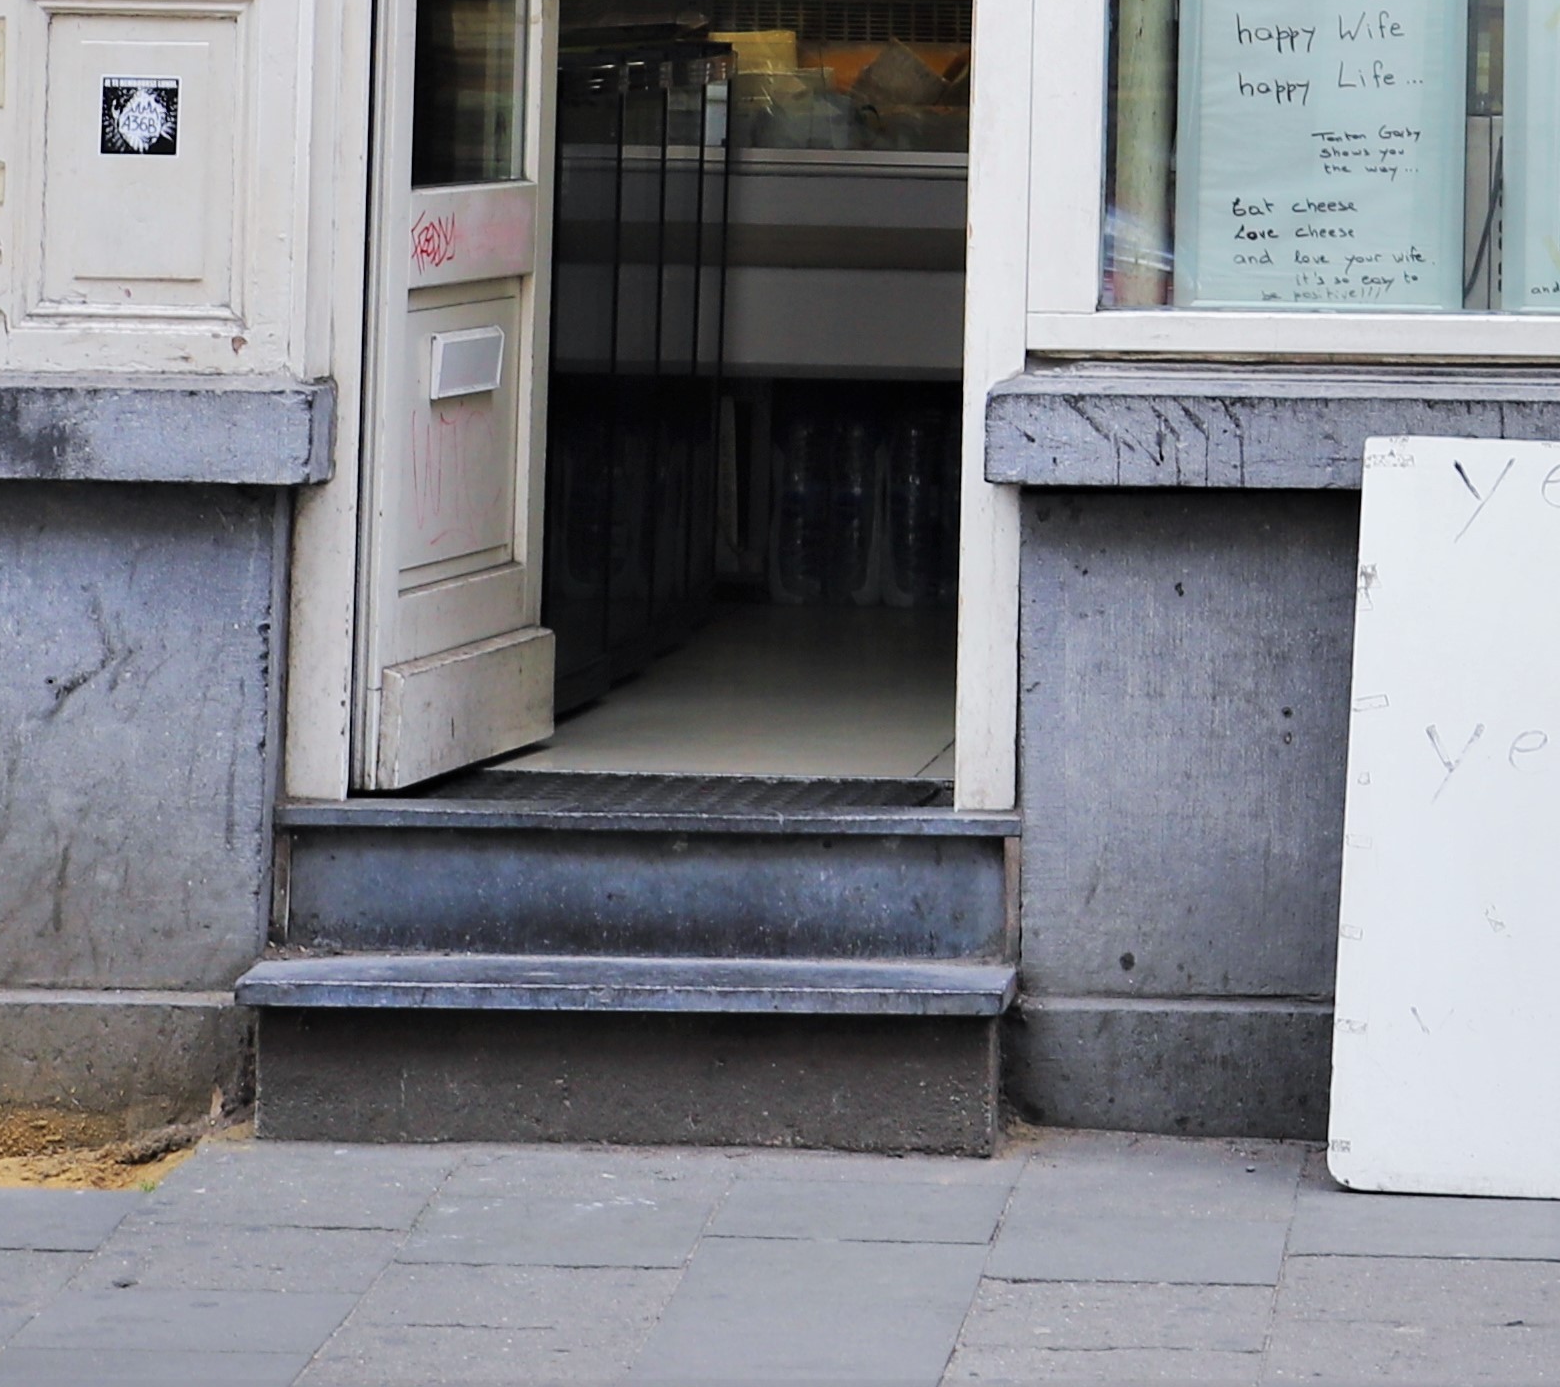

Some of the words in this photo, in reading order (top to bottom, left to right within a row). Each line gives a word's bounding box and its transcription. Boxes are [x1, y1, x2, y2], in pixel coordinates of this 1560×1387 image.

[1236, 13, 1316, 53] happy
[1338, 11, 1405, 40] Wife
[1238, 72, 1310, 106] happy
[1324, 163, 1351, 174] the
[1292, 198, 1357, 213] cheese
[1234, 225, 1279, 240] Love
[1295, 225, 1355, 238] cheese
[1233, 249, 1274, 264] and
[1294, 249, 1329, 263] love
[1345, 253, 1382, 274] your
[1361, 276, 1395, 292] easy
[1404, 271, 1419, 283] to
[1531, 283, 1560, 295] and
